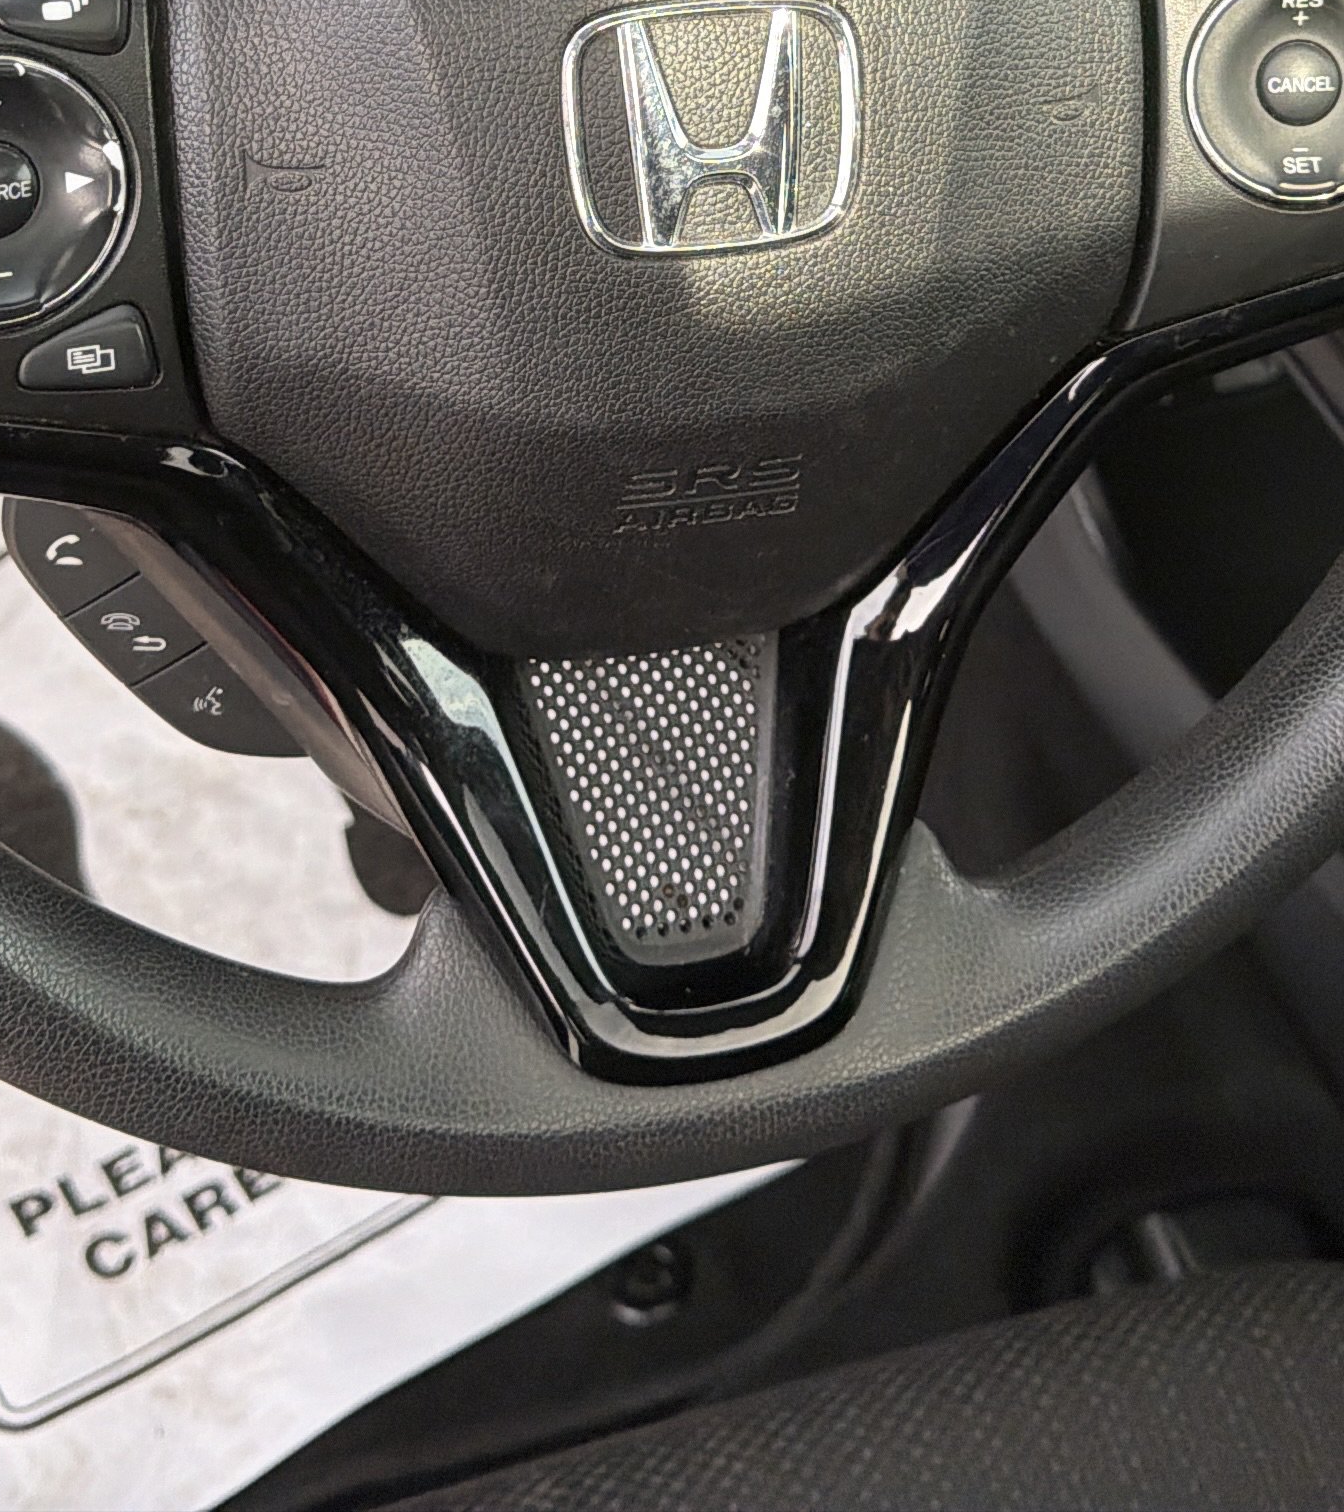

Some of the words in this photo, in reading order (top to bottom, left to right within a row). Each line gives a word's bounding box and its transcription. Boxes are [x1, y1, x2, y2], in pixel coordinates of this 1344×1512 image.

[1267, 76, 1336, 93] CANCEL
[1283, 157, 1323, 174] SET
[620, 452, 804, 500] SRS
[612, 492, 800, 536] AIRBAG
